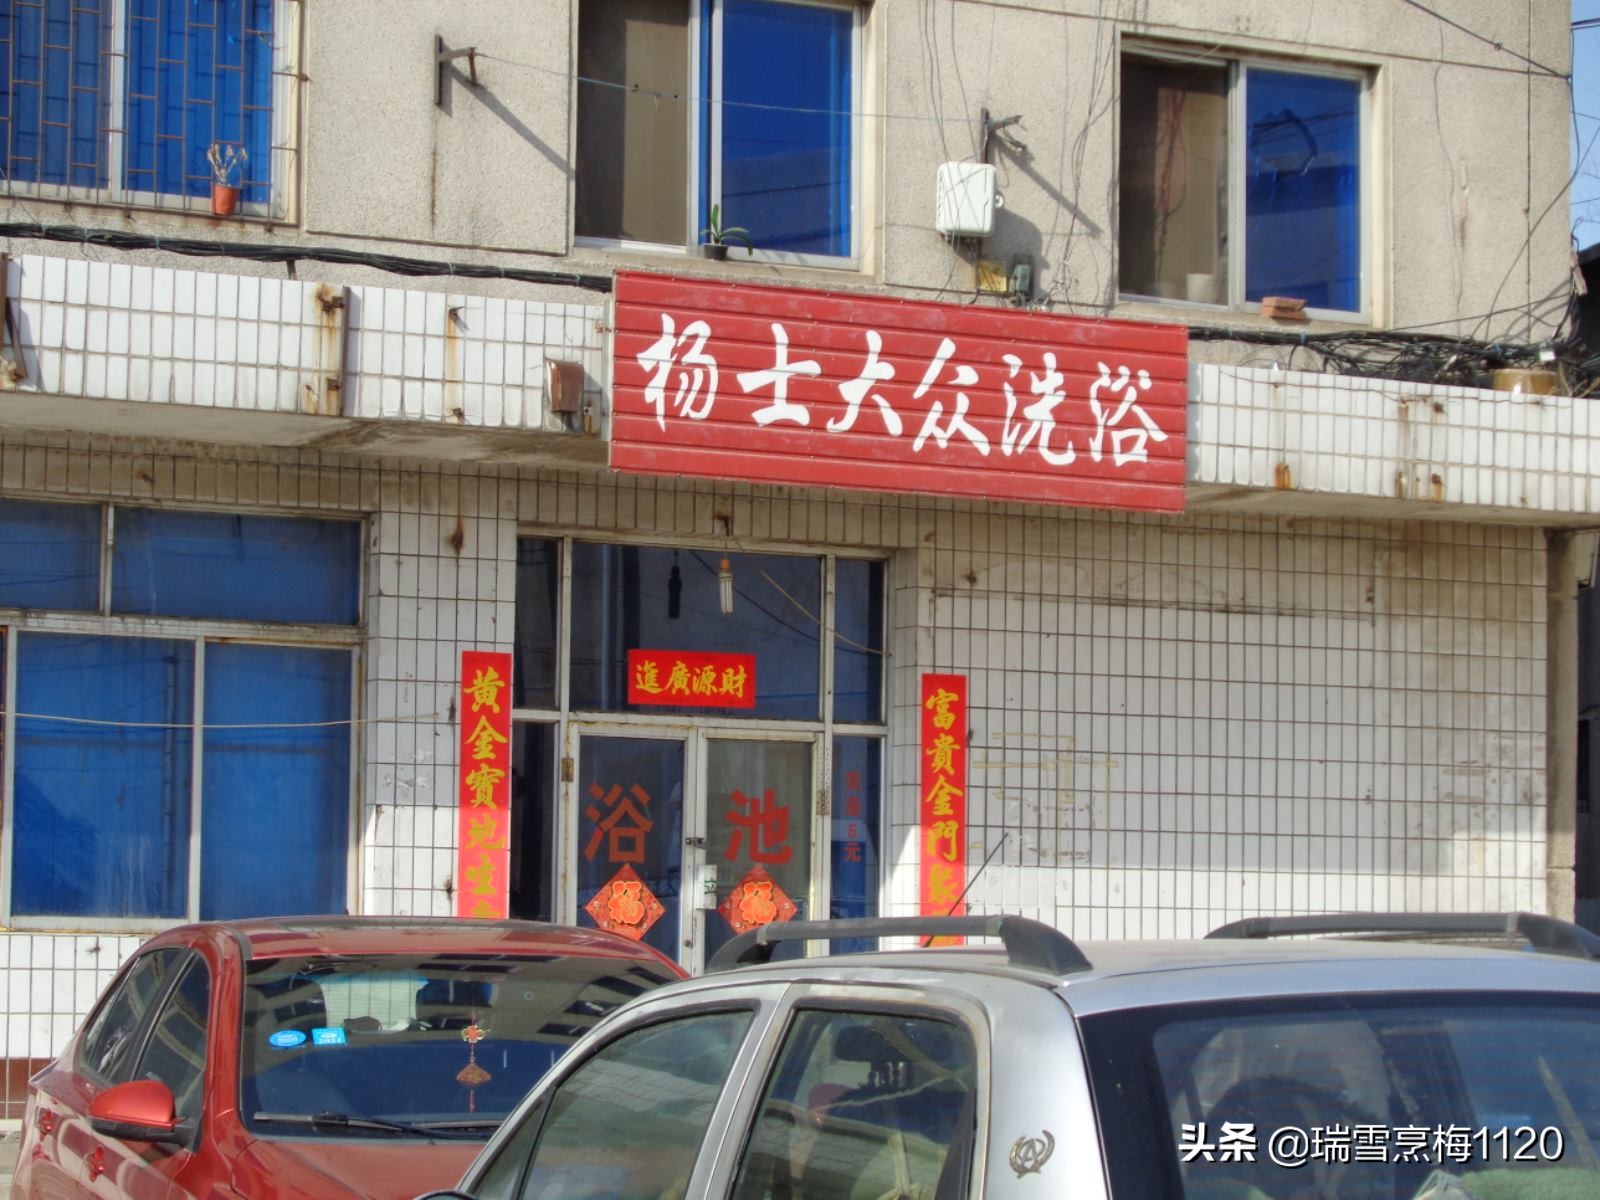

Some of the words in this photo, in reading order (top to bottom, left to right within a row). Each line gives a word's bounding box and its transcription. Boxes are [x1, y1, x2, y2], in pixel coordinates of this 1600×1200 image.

[636, 313, 1168, 467] 杨士大众洗浴
